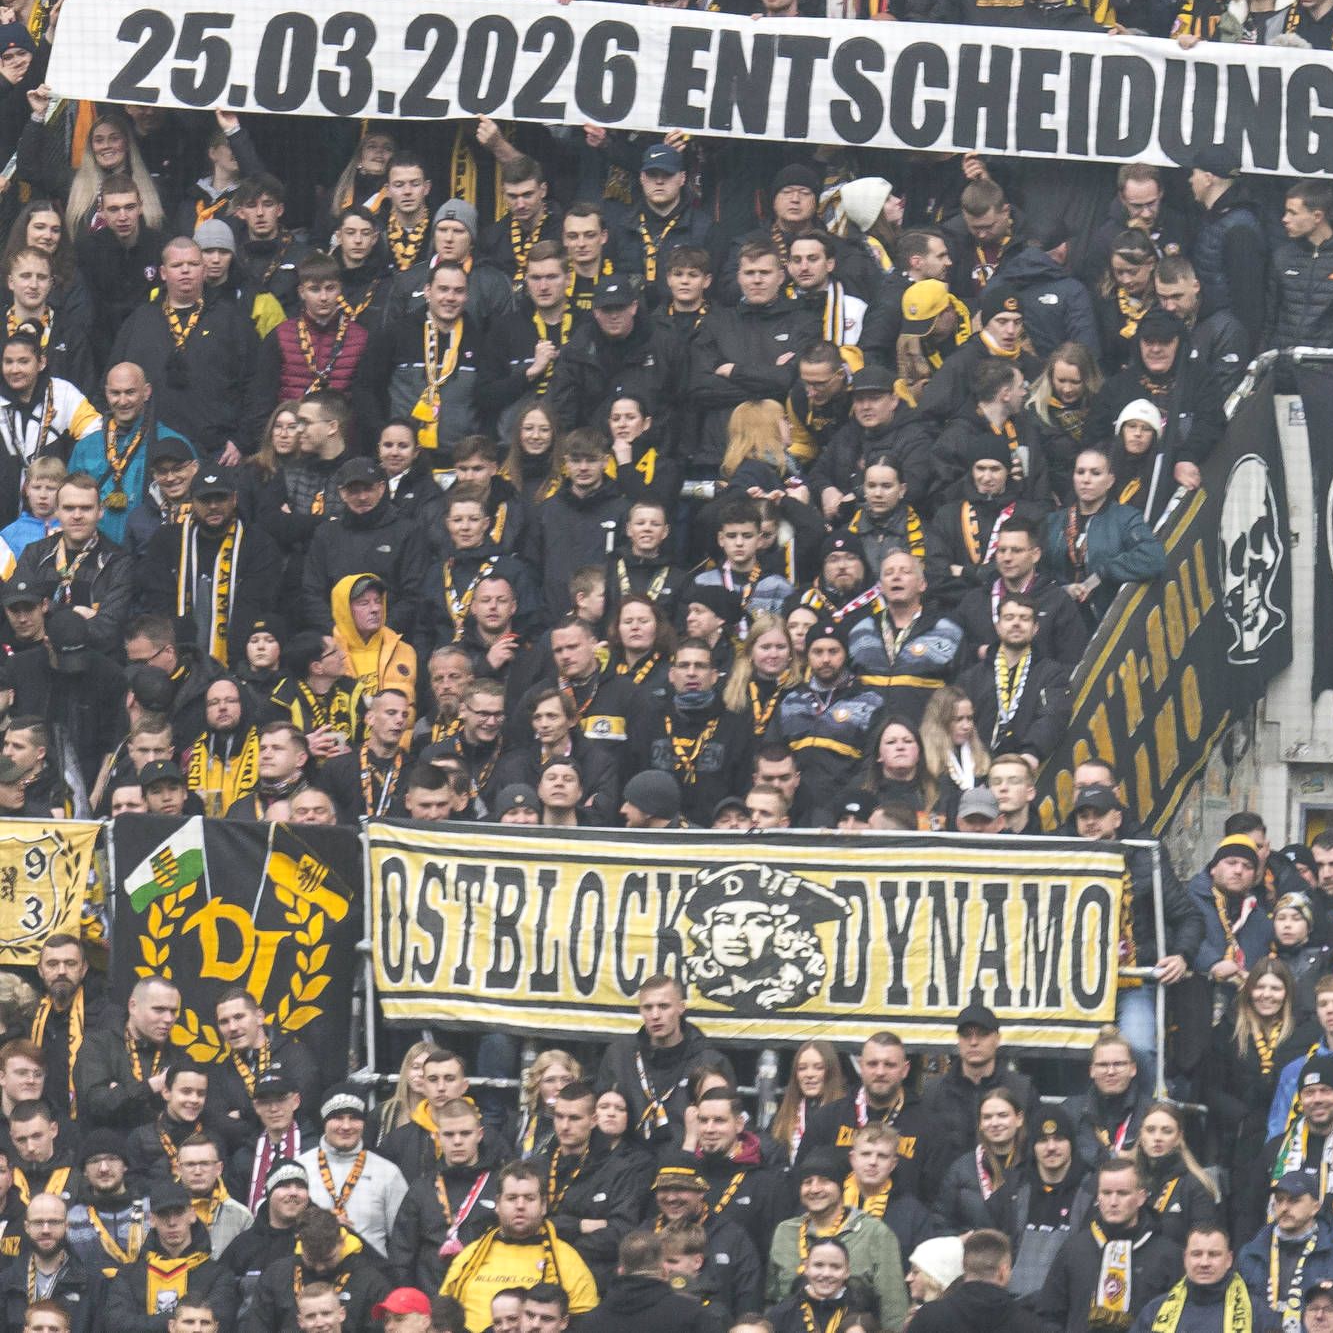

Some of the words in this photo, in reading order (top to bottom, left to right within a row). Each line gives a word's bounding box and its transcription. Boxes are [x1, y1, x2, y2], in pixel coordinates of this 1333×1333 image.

[107, 9, 640, 125] 25.03.2026
[20, 895, 44, 931] 3
[24, 846, 48, 880] 9
[377, 855, 700, 999] OSTBLOCK
[827, 879, 1113, 1011] DYNAMO
